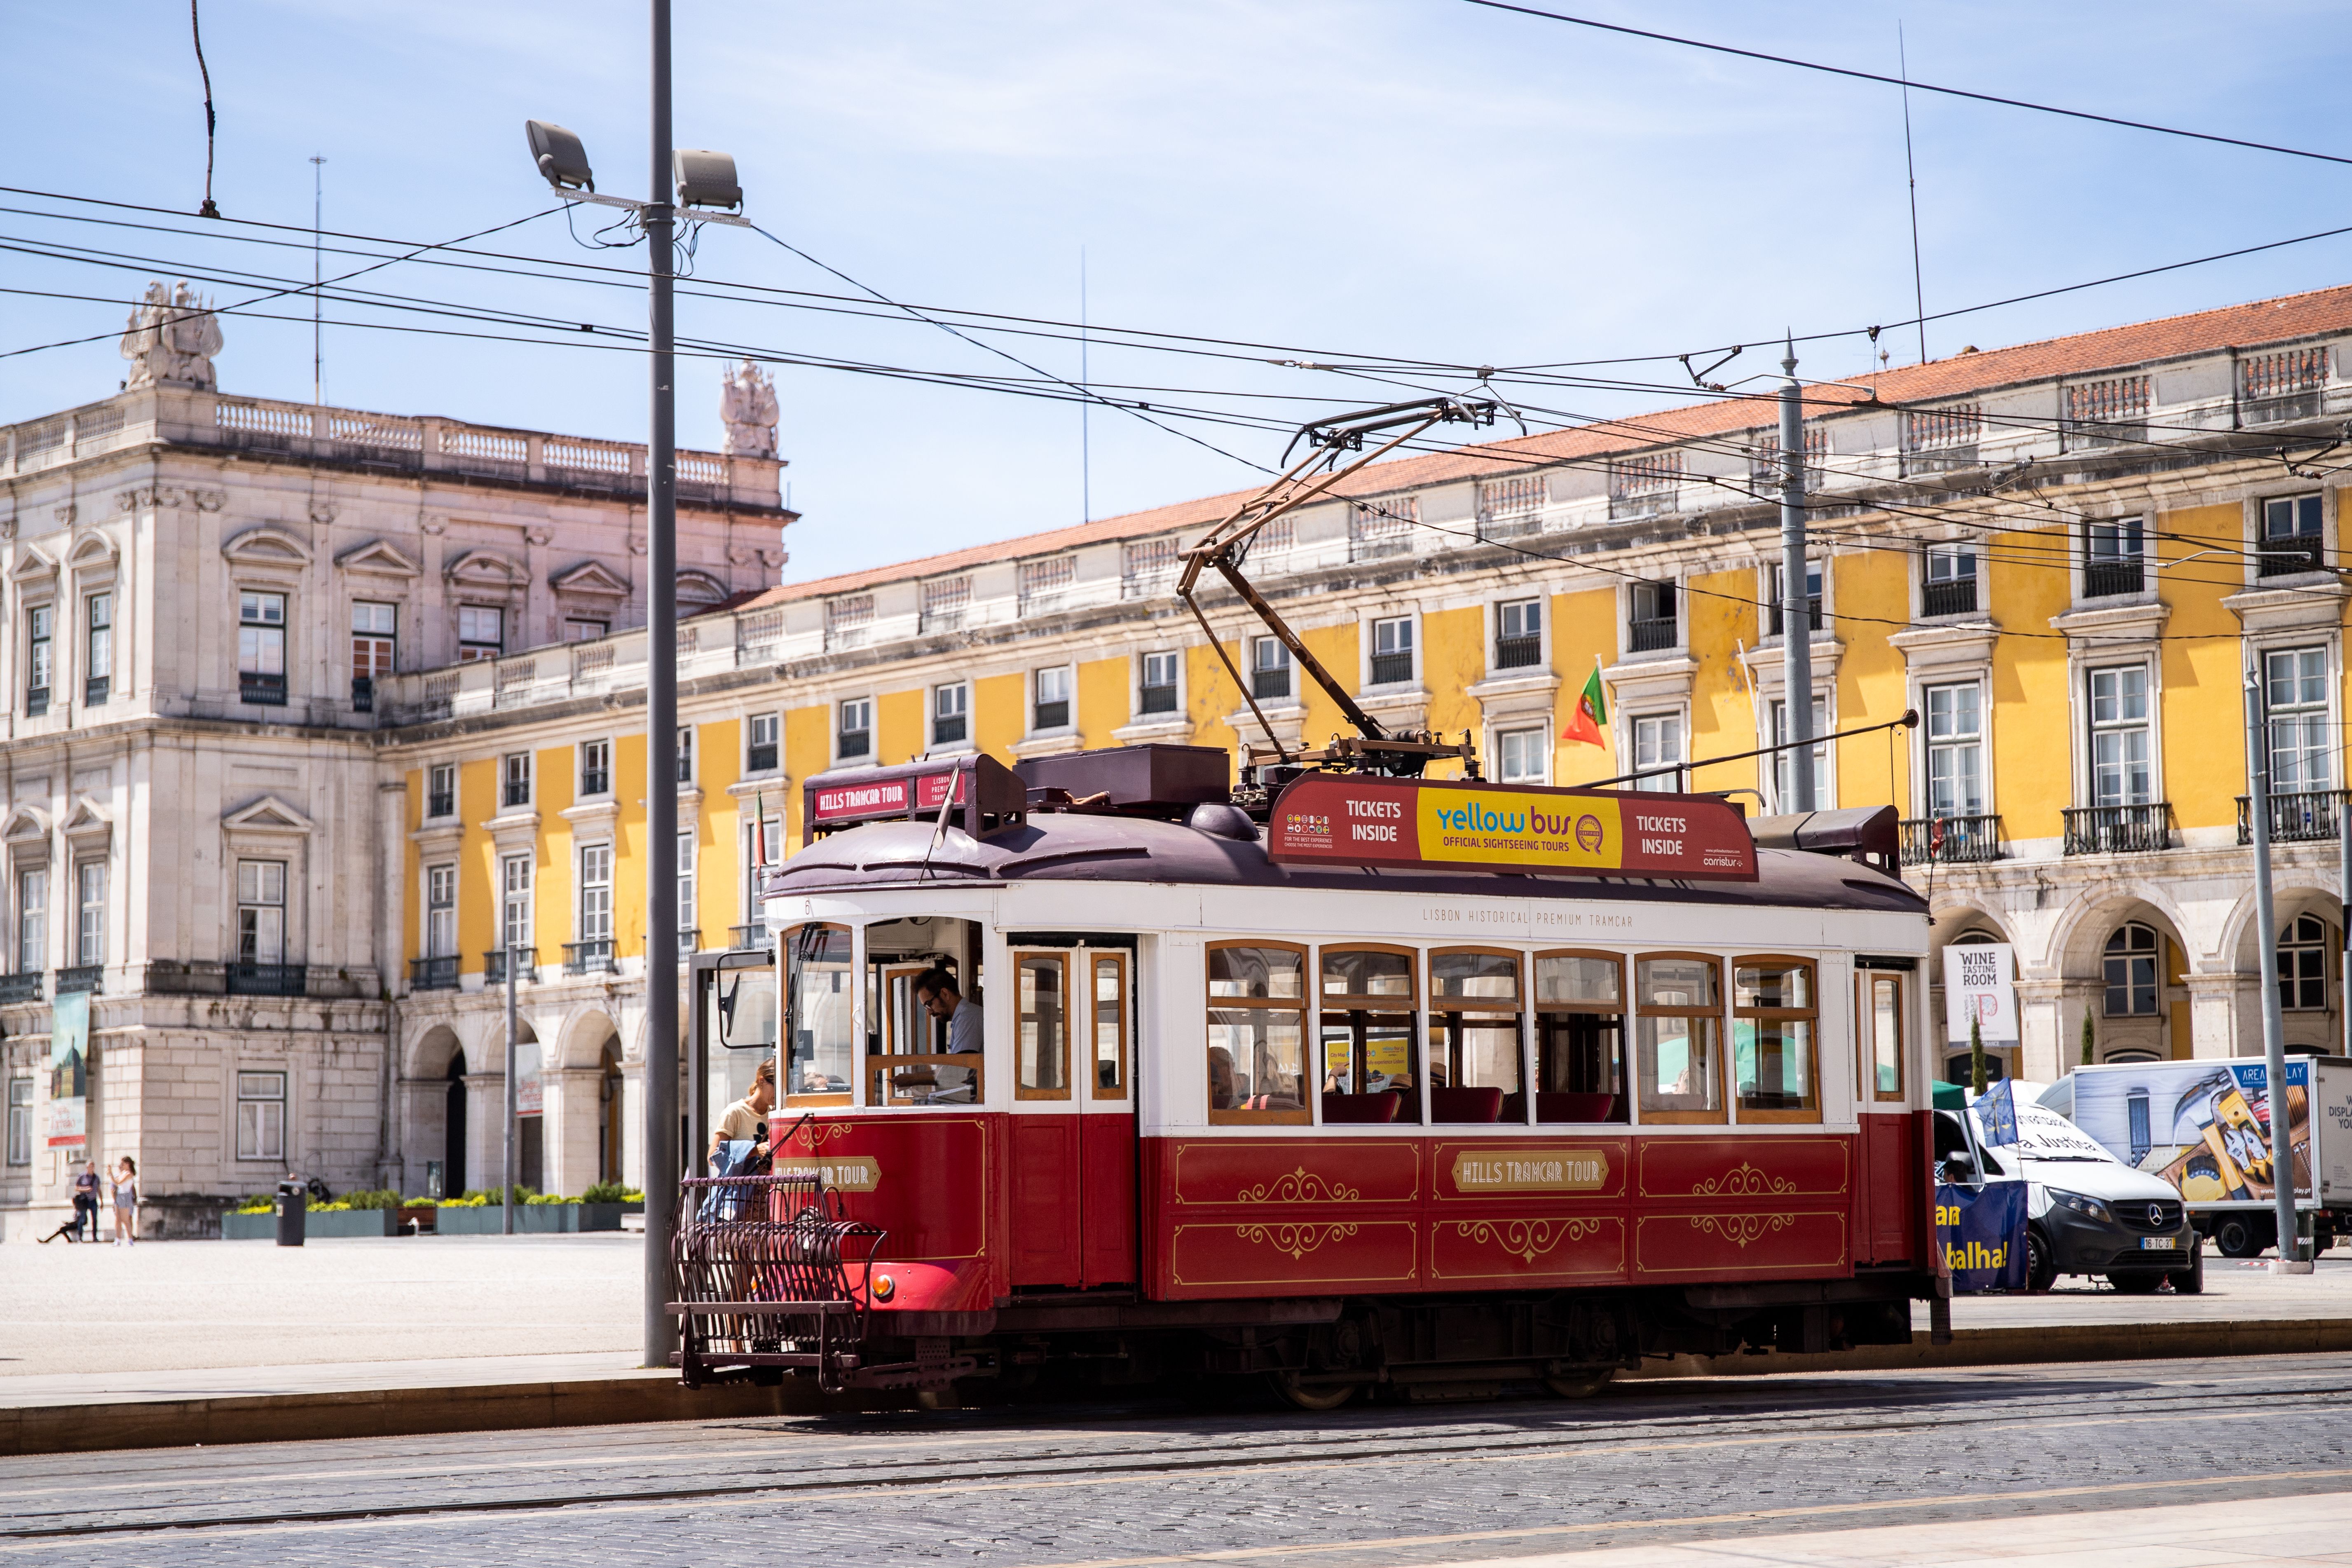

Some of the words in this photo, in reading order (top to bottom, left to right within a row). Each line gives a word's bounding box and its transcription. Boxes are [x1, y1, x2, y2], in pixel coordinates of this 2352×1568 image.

[820, 793, 843, 811] HILLS
[845, 788, 880, 808] TRAMCAR
[882, 786, 902, 803] TOUR
[1346, 800, 1401, 818] TICKETS
[1437, 802, 1525, 833] yellow
[1531, 806, 1571, 835] bus
[1636, 816, 1686, 833] TICKETS
[1352, 824, 1396, 841] INSIDE
[1443, 836, 1481, 848] OFFICIAL
[1483, 838, 1539, 851] SIGHTSEEING
[1542, 841, 1570, 852] TOURS
[1642, 838, 1683, 855] INSIDE
[1703, 857, 1736, 866] carristur
[805, 900, 810, 915] 6
[1423, 909, 1460, 921] LISBON
[1469, 910, 1528, 924] HISTORICAL
[1537, 913, 1581, 926] PREMIUM
[1589, 914, 1633, 928] TRAMCAR
[1960, 952, 1995, 965] WINE
[1962, 965, 1996, 974] TASTING
[1963, 974, 1996, 986] ROOM
[2243, 1069, 2265, 1081] AREA
[2036, 1134, 2099, 1153] Justiça
[836, 1166, 868, 1184] TOUR
[1463, 1162, 1502, 1183] HILLS
[1506, 1161, 1563, 1182] TRAMCAR
[1567, 1160, 1600, 1181] TOUR
